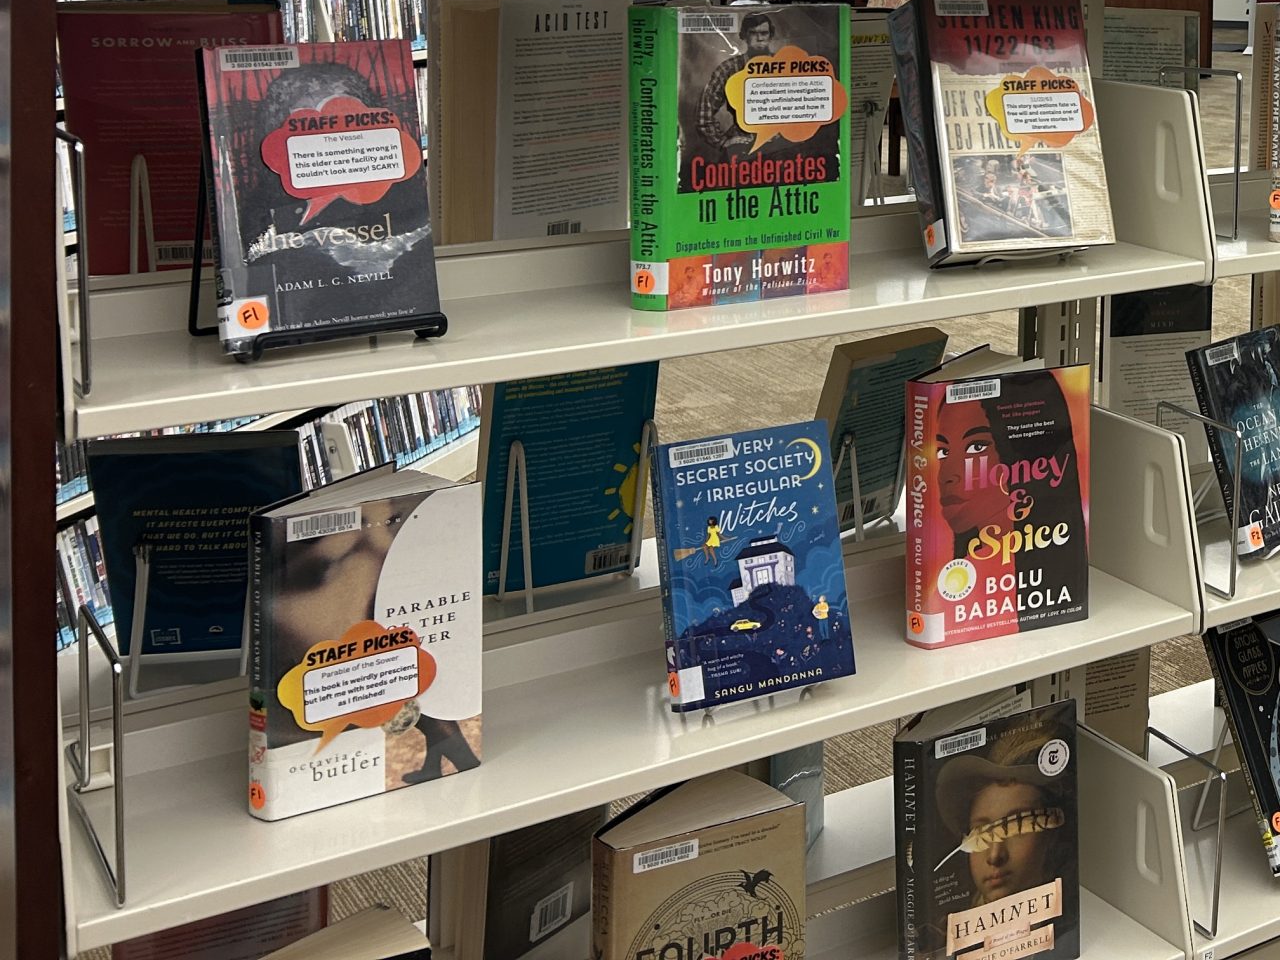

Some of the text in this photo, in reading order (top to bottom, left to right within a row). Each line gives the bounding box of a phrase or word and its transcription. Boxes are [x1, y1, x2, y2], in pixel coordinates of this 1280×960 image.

[535, 10, 609, 33] ACID TEST
[748, 61, 829, 74] STAFF PICKS:
[288, 112, 394, 132] STAFF PICKS:
[325, 147, 364, 156] something
[366, 145, 390, 153] wrong
[334, 158, 350, 166] care
[352, 156, 378, 164] facility
[296, 170, 328, 178] couldn't
[348, 165, 370, 174] away!
[372, 162, 399, 170] SCARY!
[691, 154, 826, 191] Confederates
[699, 183, 820, 223] in the Attic
[311, 213, 393, 250] vessel
[276, 271, 394, 293] ADAM L. G. NEVILL
[702, 256, 816, 287] Tony Horwitz
[733, 437, 774, 457] VERY
[676, 450, 815, 486] SECRET SOCIETY
[964, 453, 1070, 491] Honey
[706, 475, 802, 503] IRREGULAR
[718, 496, 799, 533] Witches
[1007, 489, 1034, 522] &
[968, 522, 1071, 566] Spice
[985, 568, 1043, 595] BOLU
[386, 591, 471, 618] PARABLE
[955, 586, 1072, 623] BABALOLA
[307, 630, 413, 666] STAFF PICKS:
[304, 687, 320, 696] This
[321, 682, 341, 692] book
[350, 673, 378, 684] weirdly
[380, 664, 417, 678] prescient,
[304, 697, 318, 706] but
[319, 693, 333, 702] left
[348, 685, 364, 695] with
[366, 680, 388, 690] seeds
[389, 676, 397, 685] of
[398, 673, 418, 684] hope
[714, 667, 823, 699] SANGU MANDANNA
[353, 690, 385, 703] finished!
[311, 752, 381, 783] butler
[954, 892, 1054, 940] HAMNET
